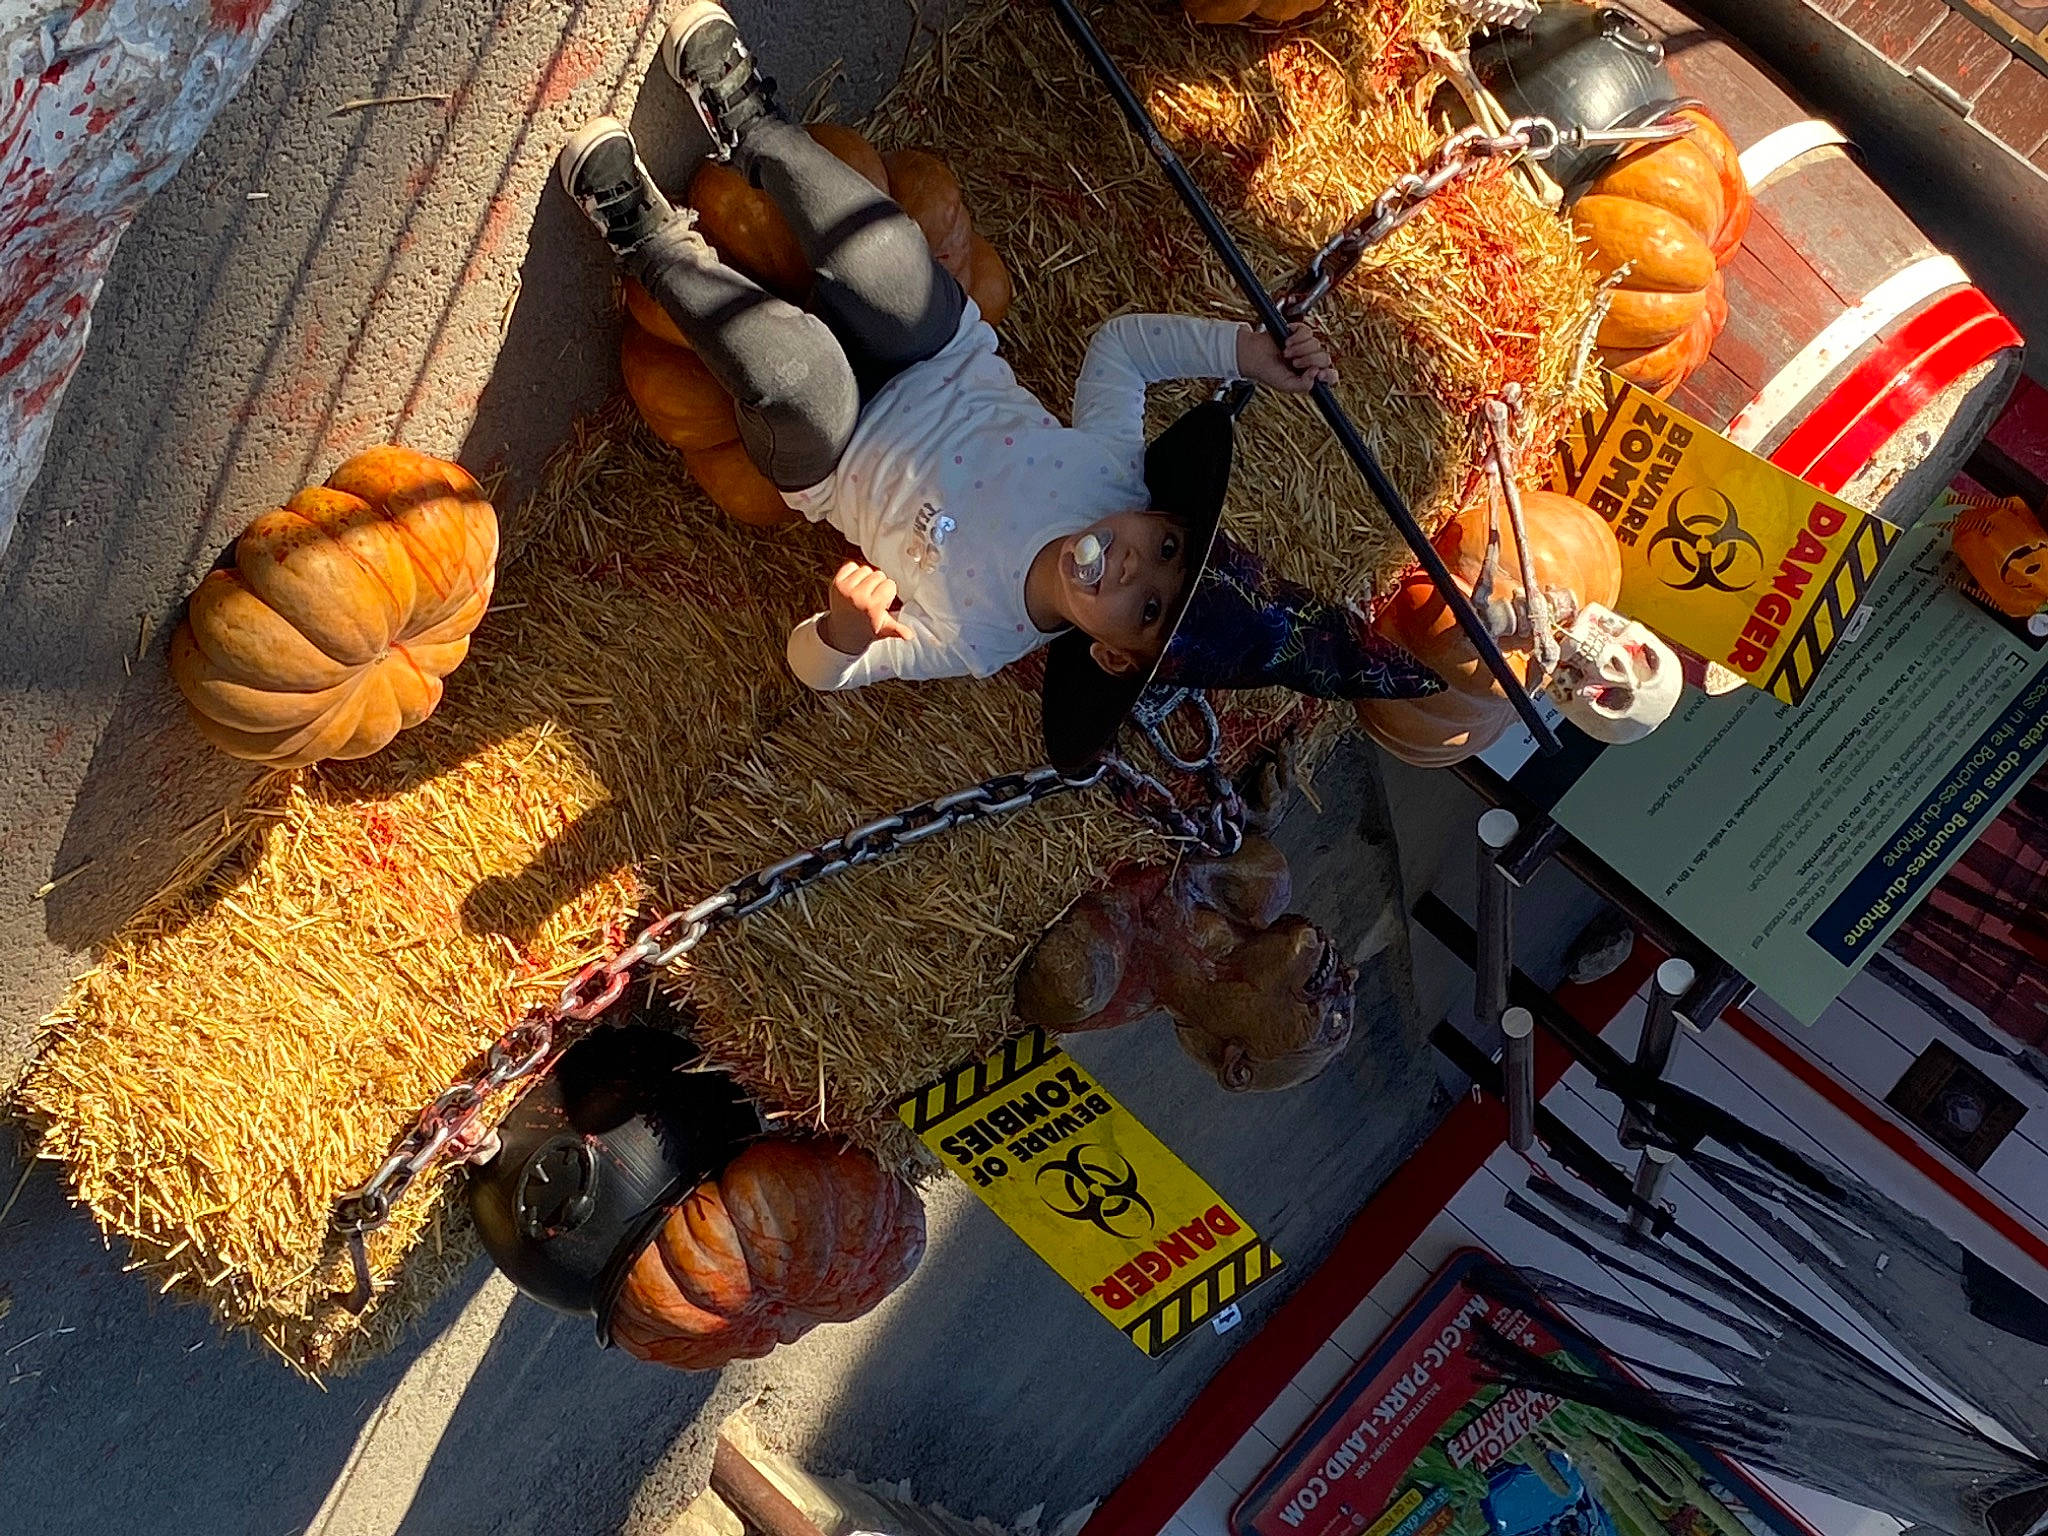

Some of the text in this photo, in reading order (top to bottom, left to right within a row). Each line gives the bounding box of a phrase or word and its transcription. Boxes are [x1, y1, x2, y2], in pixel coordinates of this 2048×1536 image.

[1586, 402, 1669, 524] ZOMB
[1614, 422, 1693, 547] BEWARE
[1726, 501, 1847, 673] DANGER
[1886, 570, 1910, 595] vocal
[1909, 609, 1920, 622] de
[1883, 622, 1910, 651] danger
[1871, 651, 1884, 663] du
[1906, 659, 1923, 674] 1st
[1844, 683, 1856, 694] la
[1886, 673, 1909, 695] June
[1877, 695, 1889, 705] to
[1858, 705, 1880, 727] 30th
[1694, 705, 1747, 764] communicated
[1782, 750, 1795, 764] est
[1888, 761, 1901, 774] du
[1682, 761, 1697, 775] the
[1882, 675, 2048, 866] cess in the Bouches-du-Rhône
[1666, 775, 1685, 792] day
[1733, 763, 1784, 818] communiquée
[1874, 774, 1892, 789] 1er
[1646, 791, 1672, 816] before
[1858, 785, 1878, 806] juin
[1848, 805, 1861, 819] au
[1724, 818, 1736, 828] la
[1836, 818, 1851, 833] 30
[1843, 710, 2048, 945] orêts dans les Bouches-du-Rhône
[1676, 866, 1694, 882] 18h
[1665, 882, 1678, 896] sur
[940, 1066, 1092, 1166] ZOMBIES
[971, 1093, 1112, 1187] BEWARE OF
[1091, 1204, 1240, 1309] DANGER
[1278, 1294, 1489, 1527] MAGIC-PARK-LAND.COM
[1391, 1424, 1403, 1438] EN
[1470, 1393, 1562, 1474] ENSATION
[1368, 1436, 1393, 1462] LIGNE
[1354, 1460, 1371, 1479] SUR
